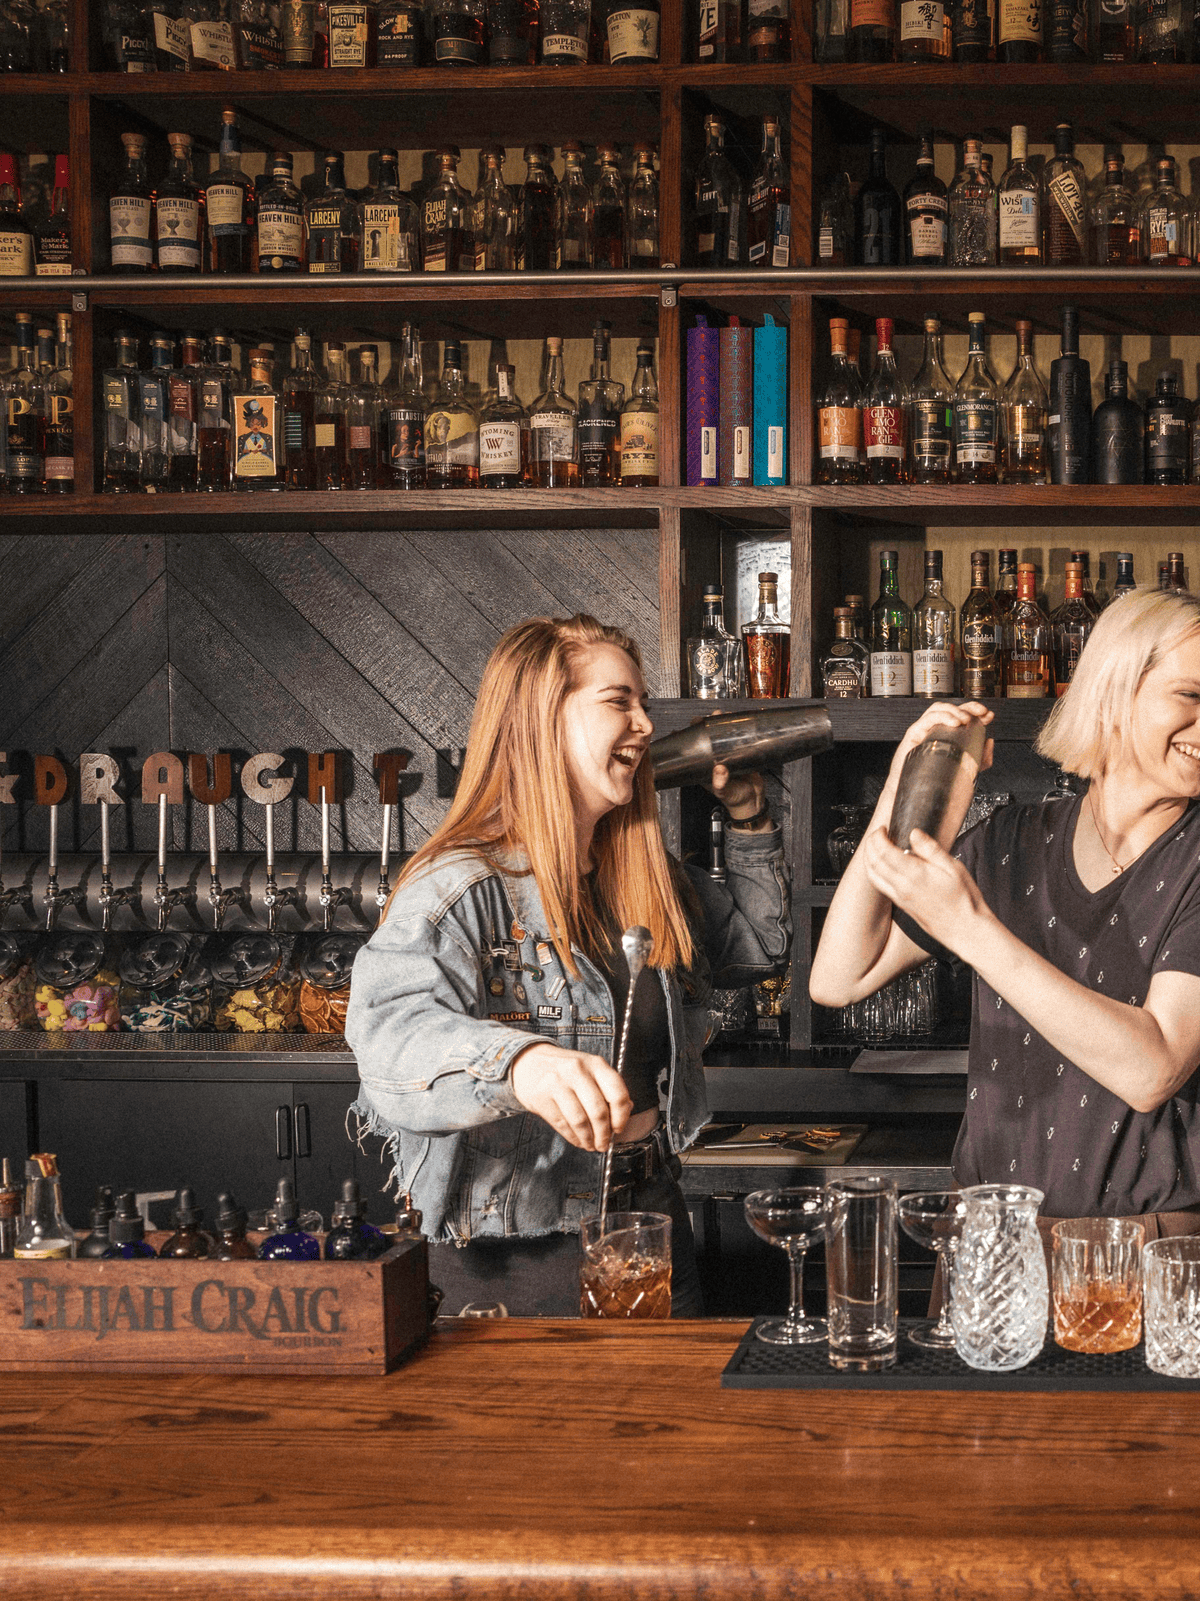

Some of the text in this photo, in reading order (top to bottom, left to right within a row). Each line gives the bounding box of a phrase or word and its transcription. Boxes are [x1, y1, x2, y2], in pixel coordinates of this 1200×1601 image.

[331, 14, 364, 28] PIKESVILLE
[905, 20, 924, 28] HIBIKI
[1058, 174, 1079, 198] LOT
[226, 188, 238, 196] HILL
[132, 199, 145, 209] HILL
[180, 200, 194, 210] HILL
[426, 200, 447, 213] ELIJAH
[908, 198, 926, 208] FORTY
[259, 213, 301, 225] HEAVEN HILL
[310, 211, 341, 225] LARCENY
[365, 209, 398, 223] LARCENY
[425, 210, 447, 225] CRAIG
[1150, 220, 1167, 234] RYE
[41, 237, 69, 245] Maker's
[1063, 372, 1074, 424] OCTOMORE
[8, 398, 31, 426] P
[49, 395, 74, 425] P
[822, 409, 846, 418] GLEN
[870, 409, 895, 419] GLEN
[390, 412, 404, 421] STILL
[879, 418, 895, 427] MO
[824, 427, 841, 436] RAN
[871, 427, 890, 436] RAN
[877, 436, 894, 445] GIE
[964, 634, 994, 644] Glenfiddich
[697, 645, 718, 658] BLADE
[873, 654, 905, 665] Glenfiddich
[915, 653, 949, 664] Glenfiddich
[828, 679, 858, 687] CARDHU
[878, 671, 896, 687] 12
[921, 668, 940, 687] 15
[539, 1006, 562, 1016] MILF
[18, 1277, 177, 1341] ELIJAH
[271, 1336, 343, 1347] BOURBON
